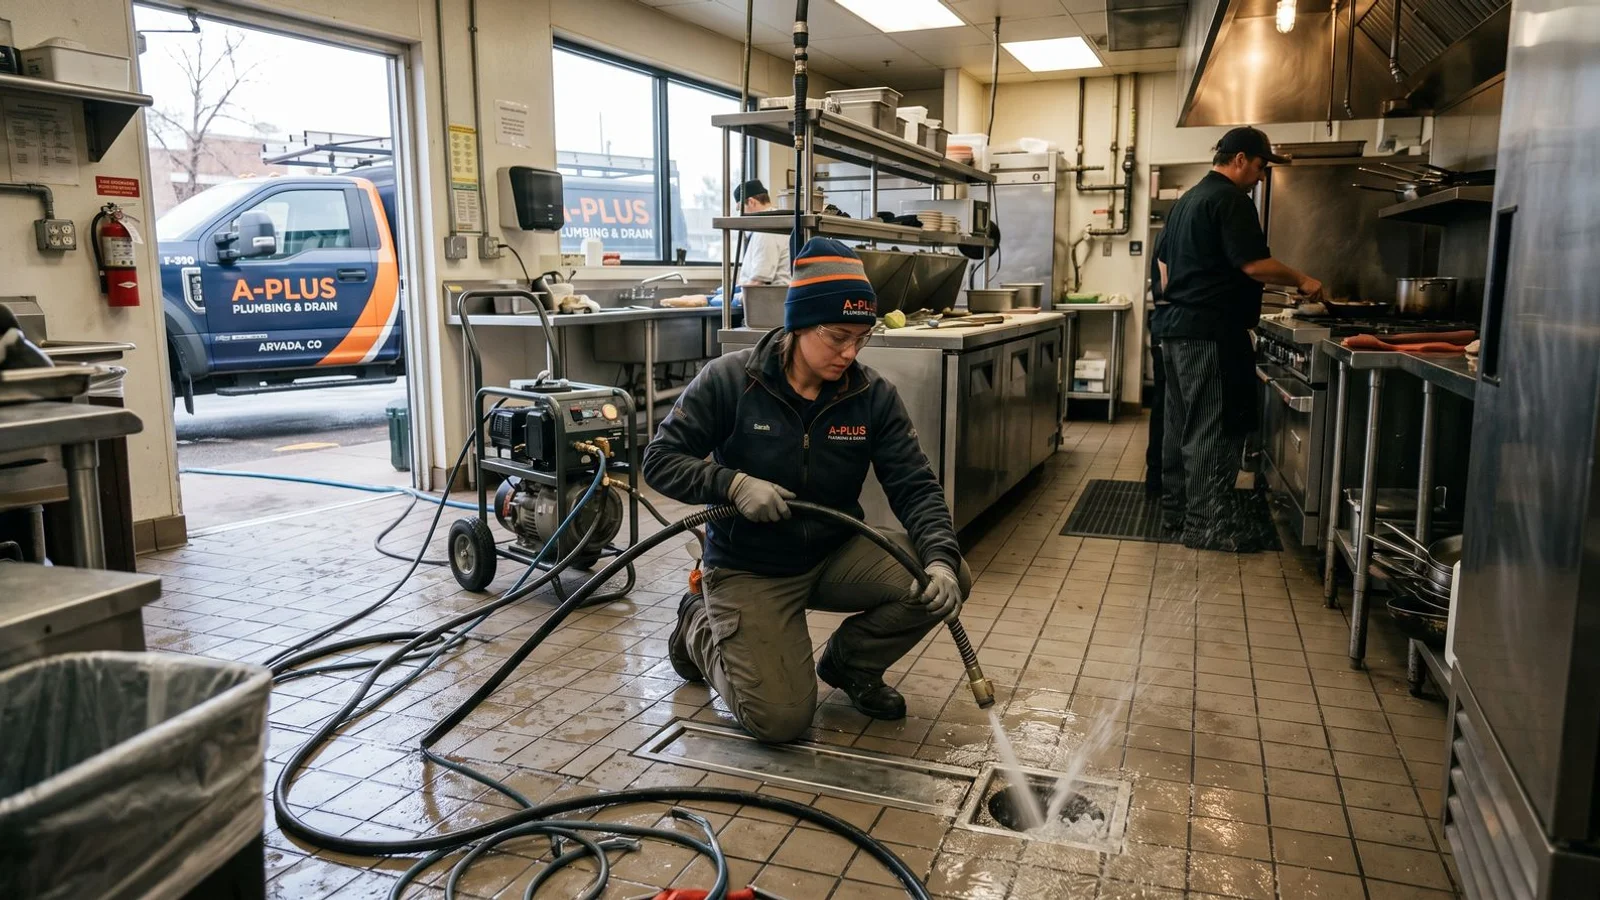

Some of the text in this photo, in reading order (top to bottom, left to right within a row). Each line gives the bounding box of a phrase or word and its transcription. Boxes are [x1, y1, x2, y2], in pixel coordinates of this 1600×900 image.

[560, 226, 653, 239] LUMBING & DRAIN
[231, 277, 337, 302] A-PLUS
[232, 301, 338, 314] PLUMBING & DRAIN
[258, 339, 322, 352] ARVADA, CO
[754, 423, 770, 431] Sarah
[828, 425, 866, 436] A-PLUS
